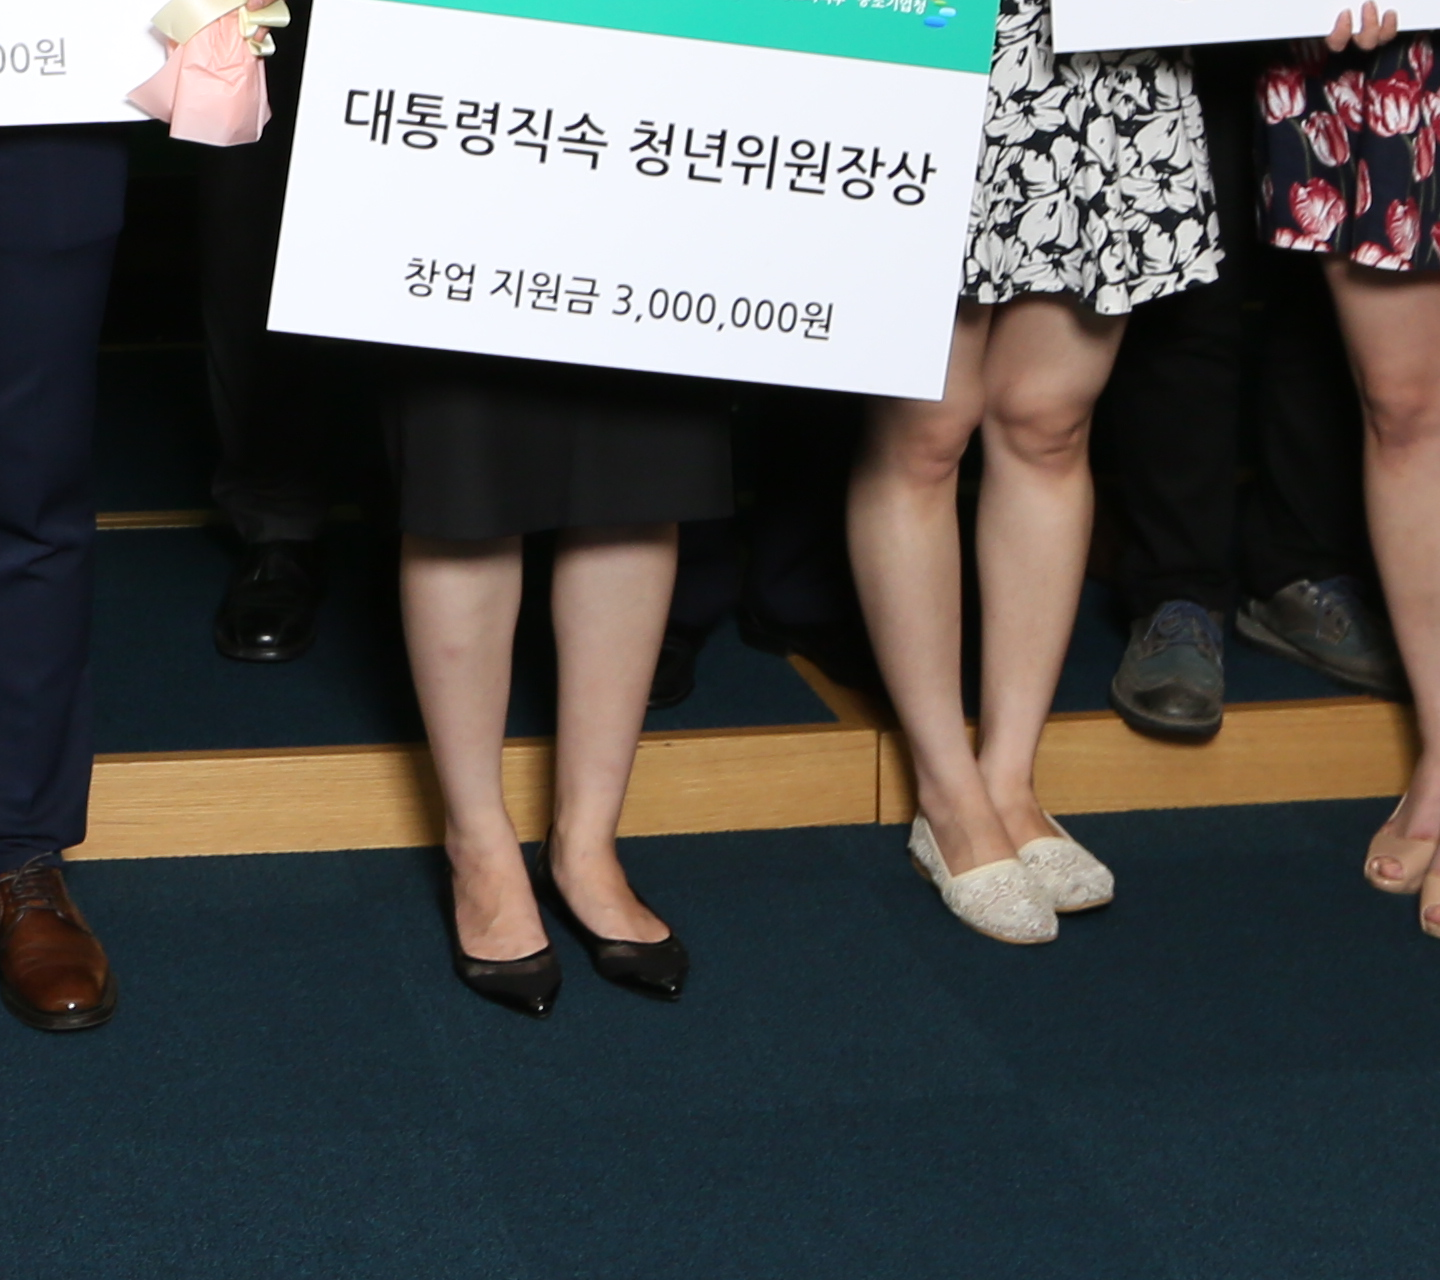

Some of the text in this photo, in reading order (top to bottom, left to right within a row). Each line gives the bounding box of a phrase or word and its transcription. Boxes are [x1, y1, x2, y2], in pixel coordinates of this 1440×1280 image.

[342, 87, 938, 206] 대통령직속 청년위원장상
[404, 257, 834, 341] 창업 지원금 3,000,000원
